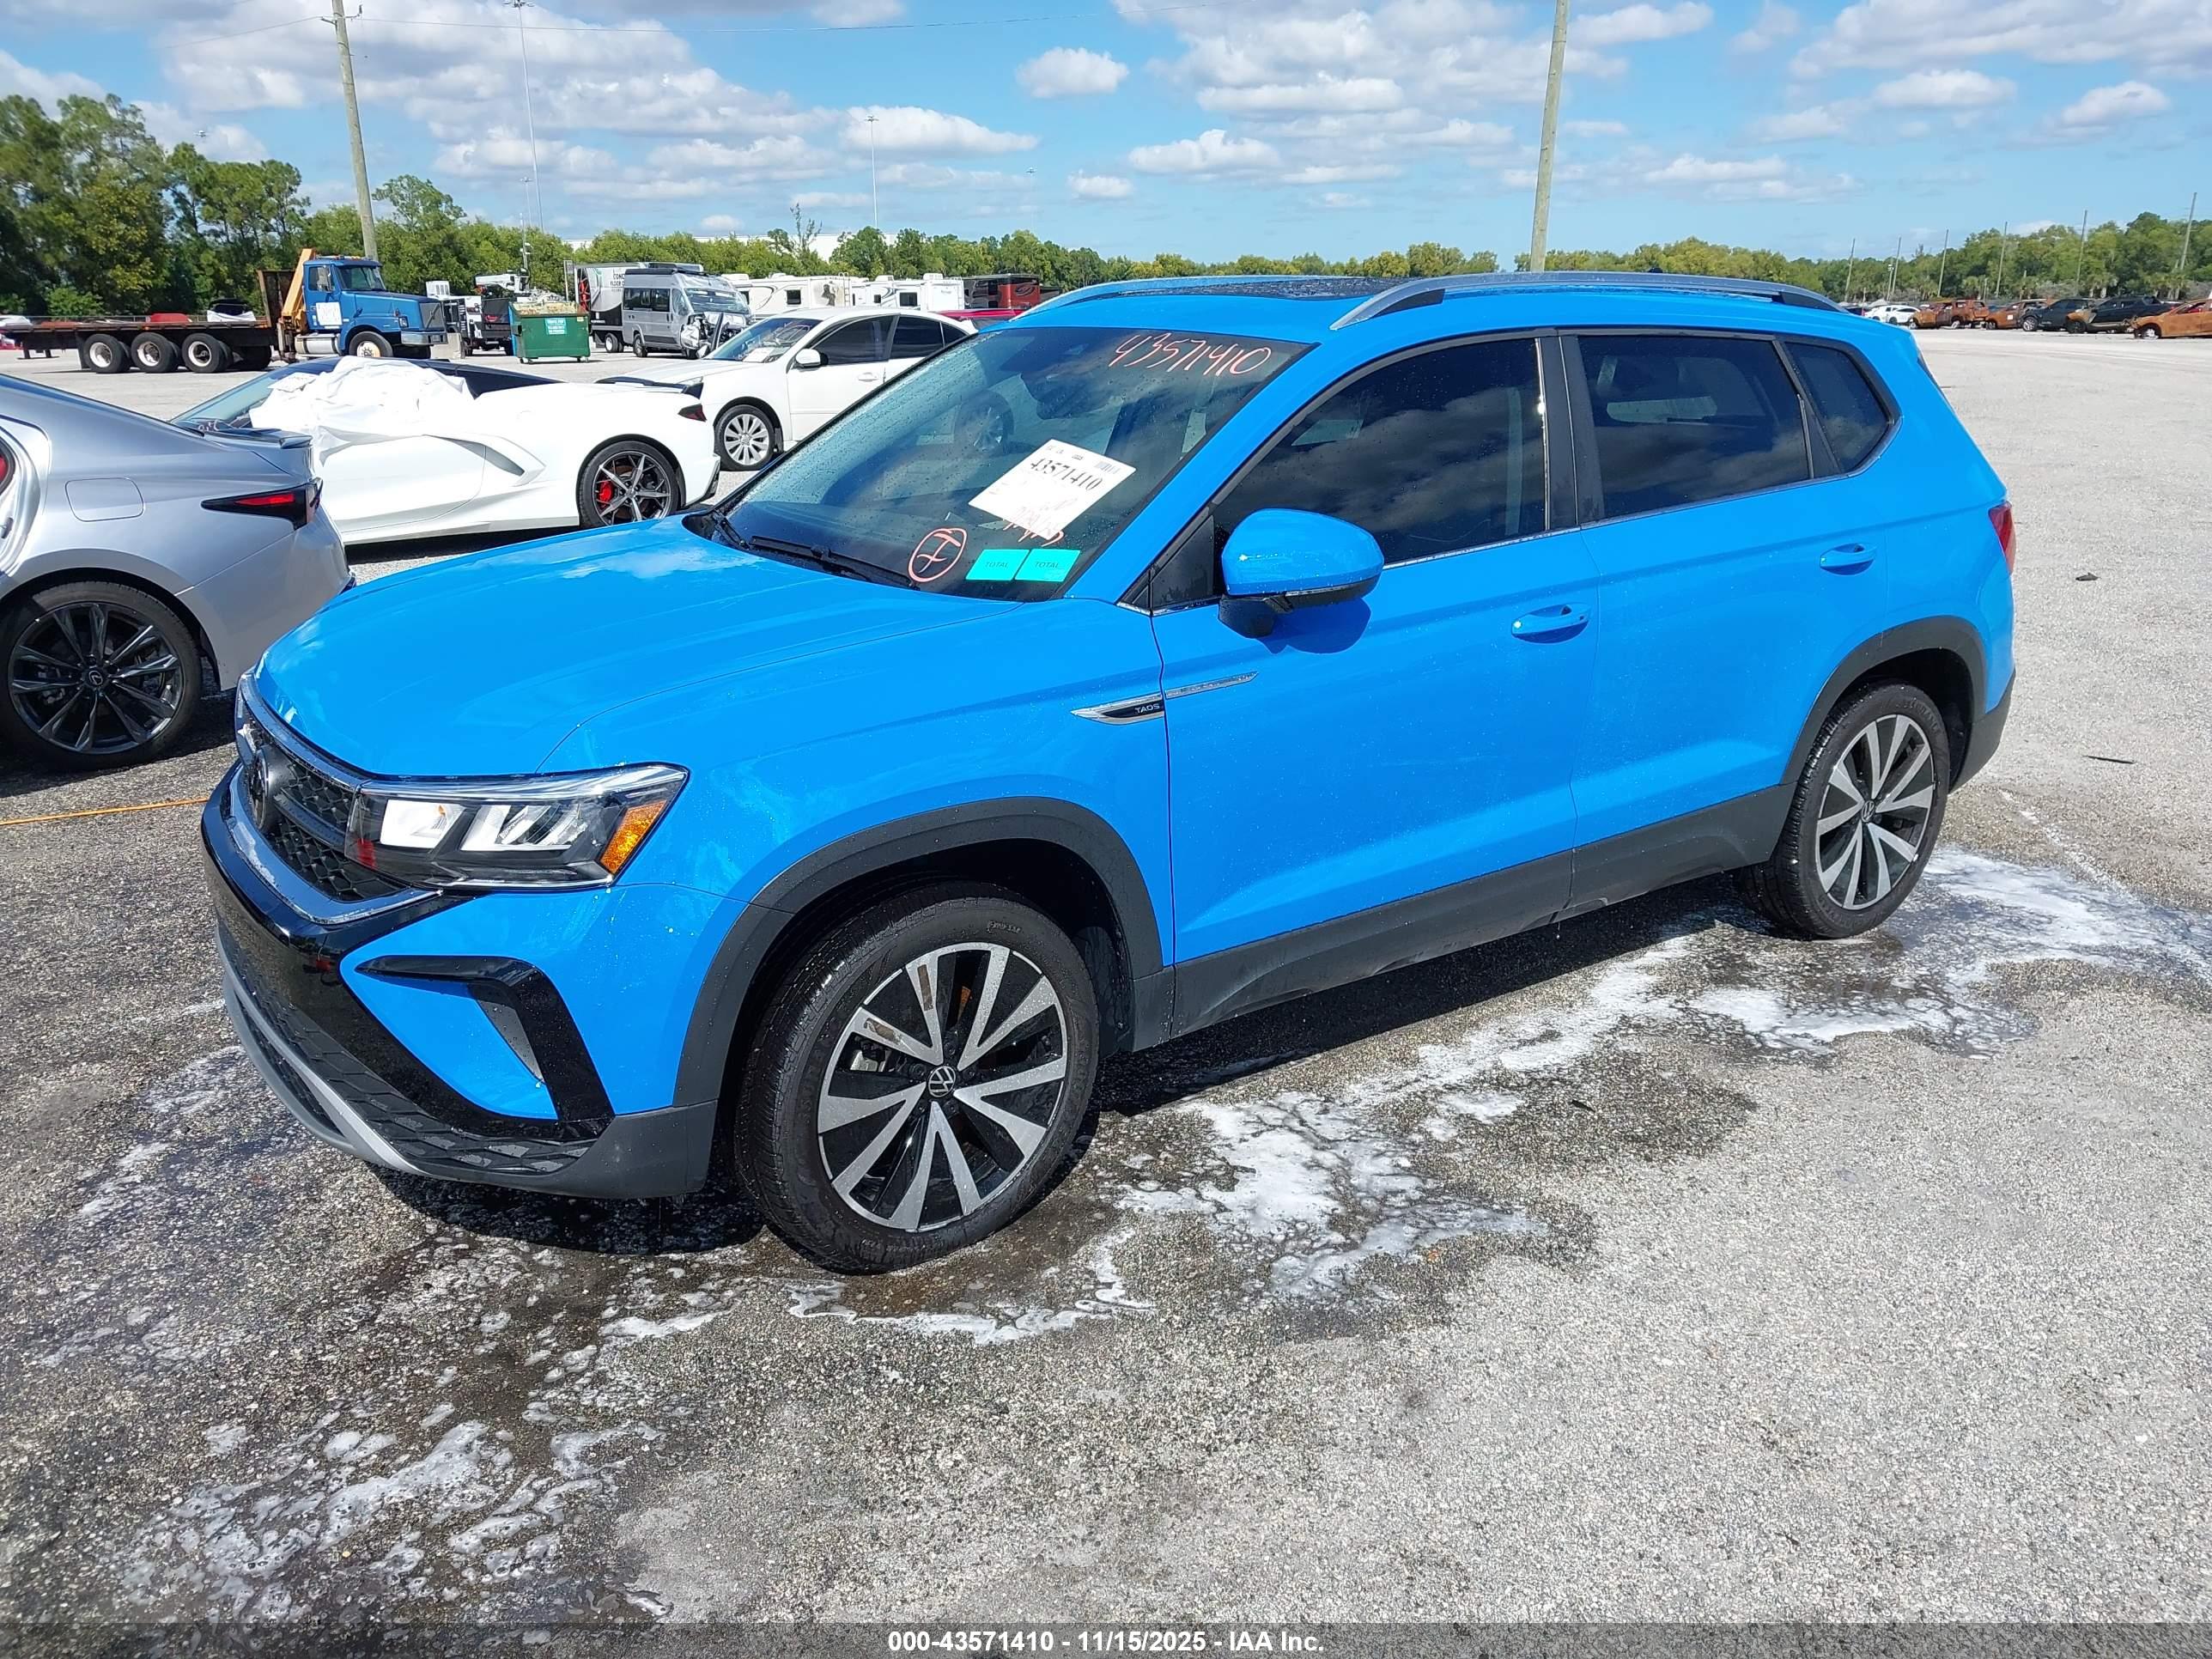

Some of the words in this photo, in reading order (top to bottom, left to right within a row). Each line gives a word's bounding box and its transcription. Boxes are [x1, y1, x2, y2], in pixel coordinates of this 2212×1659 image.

[1108, 332, 1272, 376] 43571410
[1030, 457, 1104, 491] 43571410
[1134, 703, 1160, 714] TAOS
